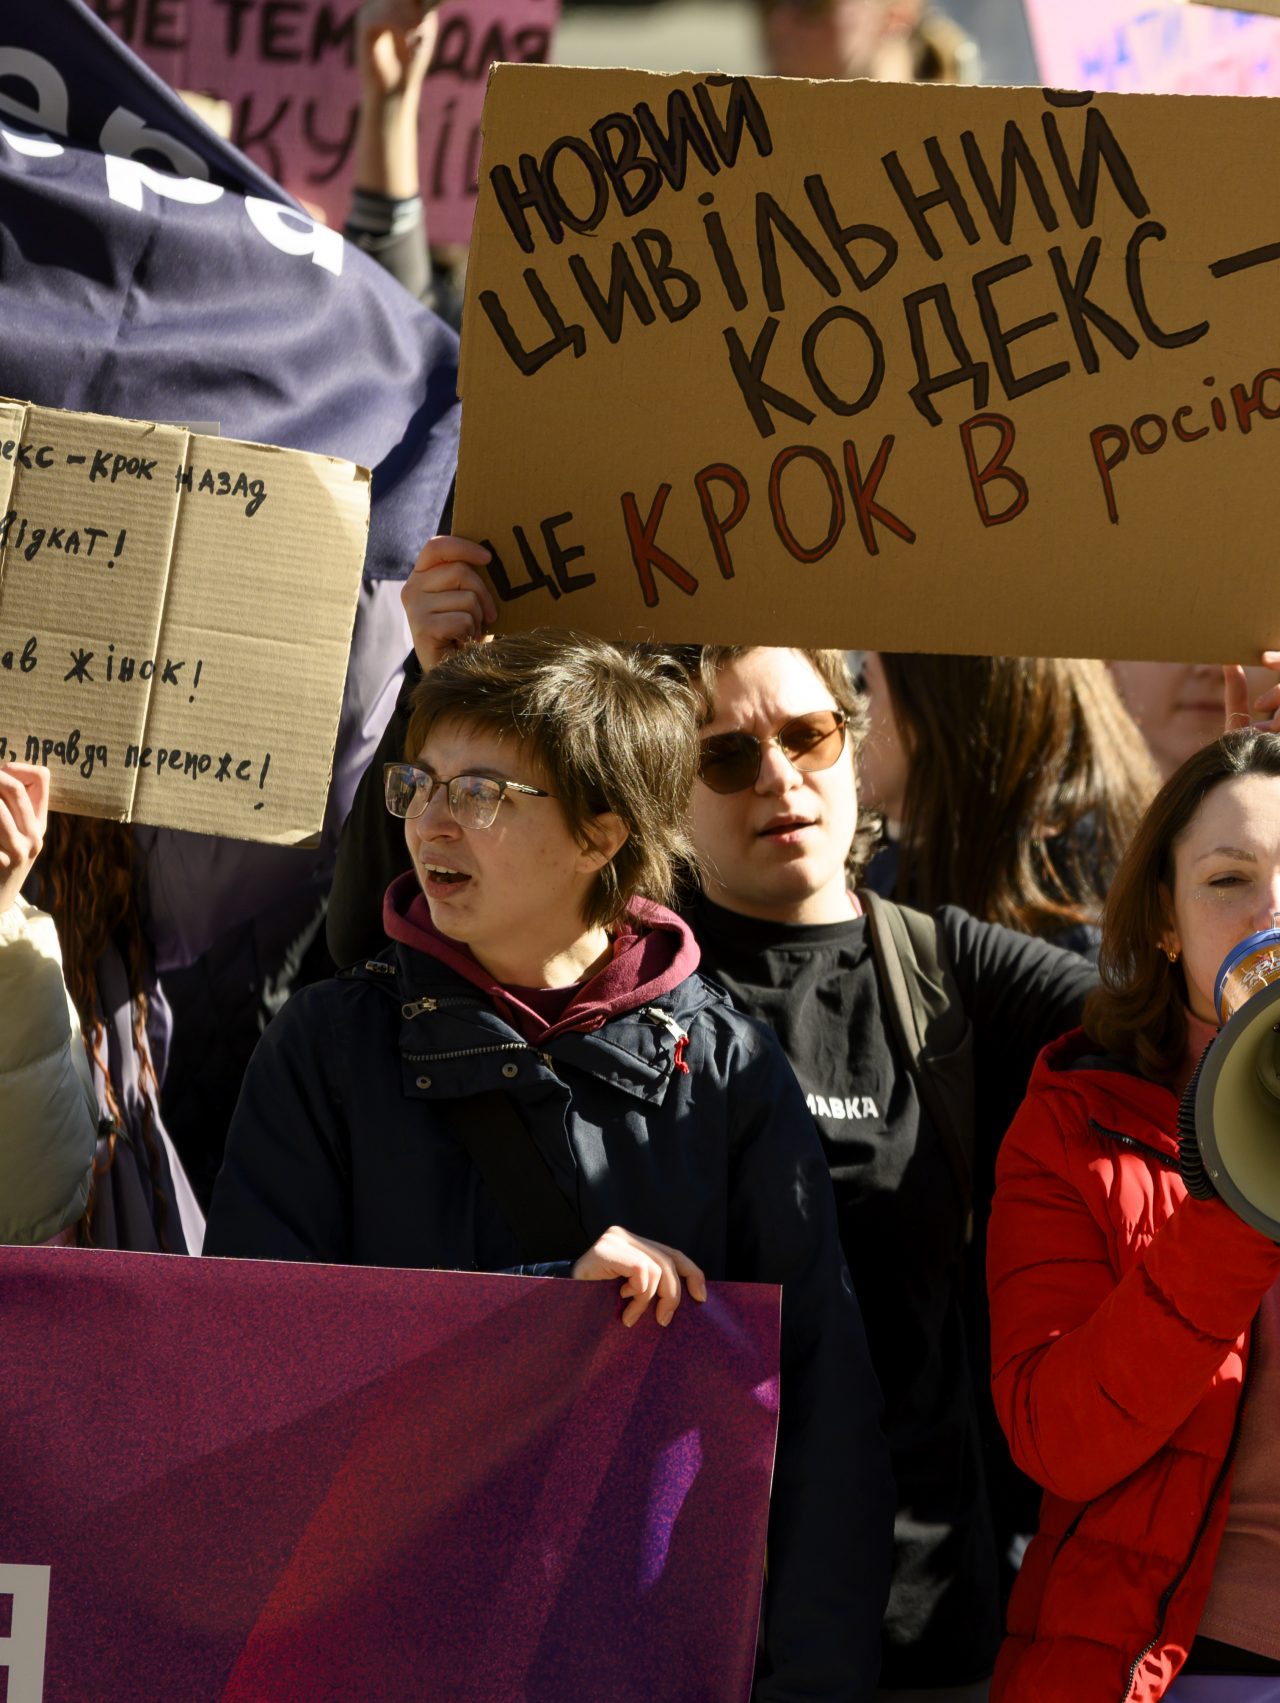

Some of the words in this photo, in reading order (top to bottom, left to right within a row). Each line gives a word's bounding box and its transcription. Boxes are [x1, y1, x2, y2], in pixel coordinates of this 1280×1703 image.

[214, 0, 358, 68] ТЕМ
[488, 75, 773, 254] НОВИЙ
[0, 440, 54, 470] екс
[483, 511, 596, 601] ЦЕ
[620, 434, 916, 608] КРОК
[959, 413, 1029, 528] В
[25, 729, 108, 780] правда
[125, 742, 271, 811] переможе!
